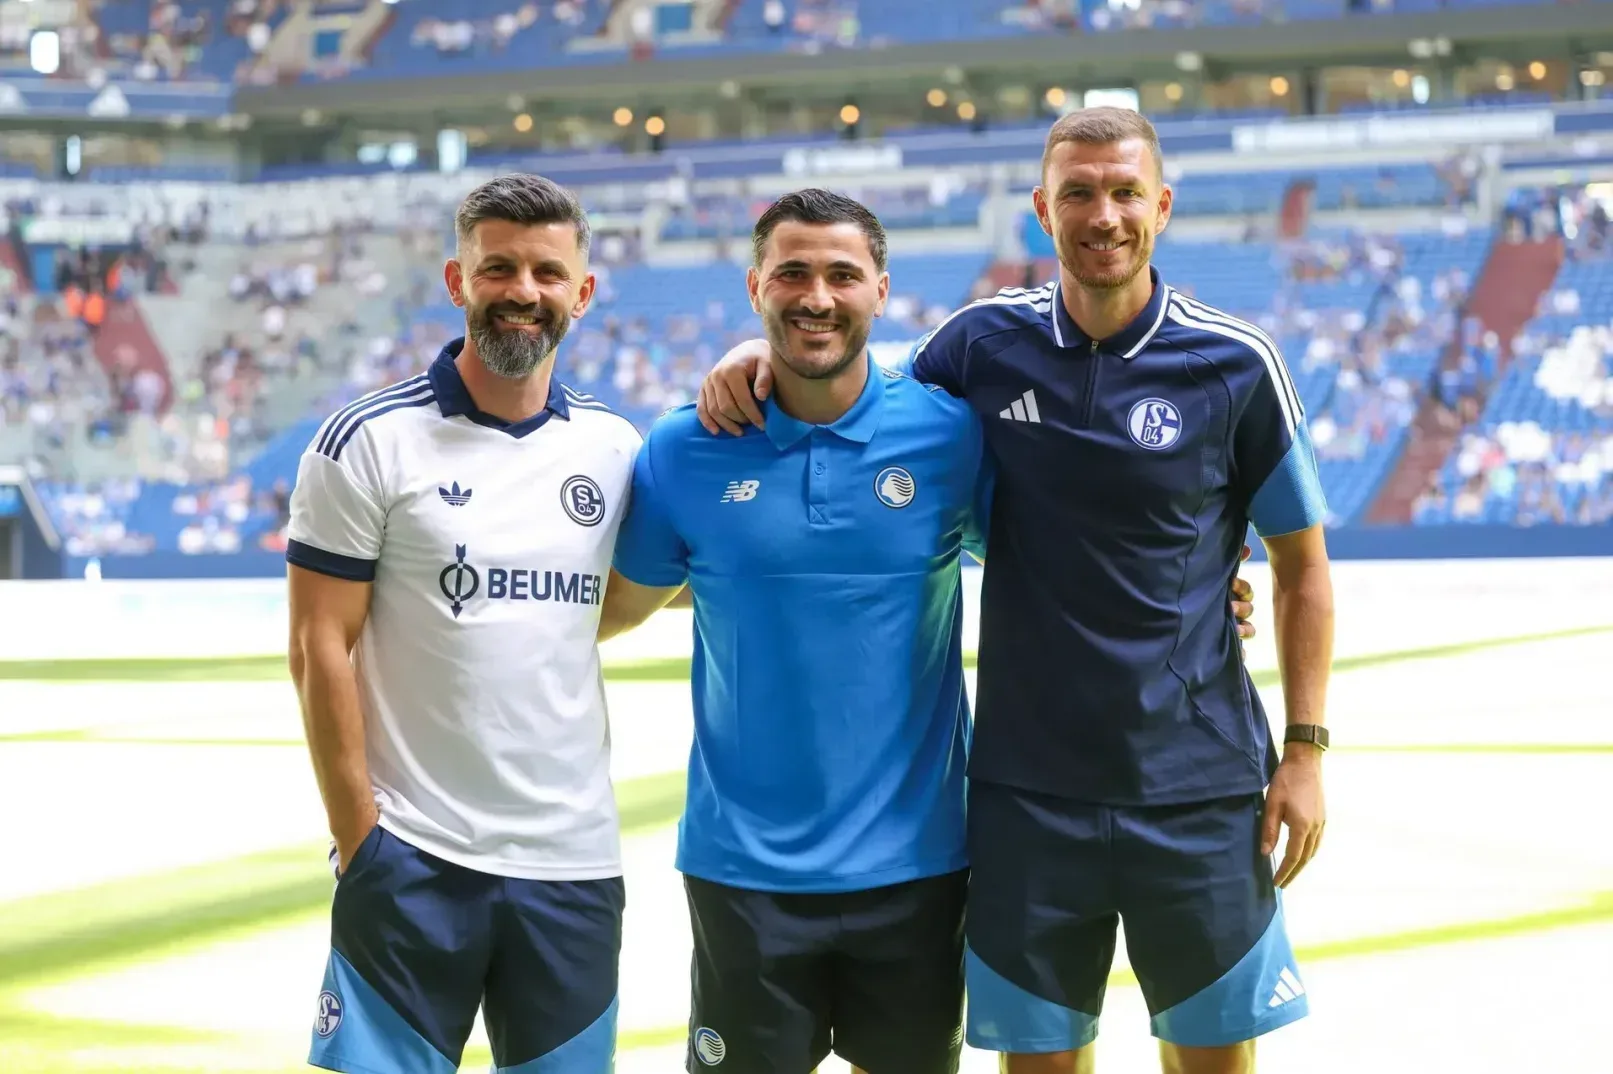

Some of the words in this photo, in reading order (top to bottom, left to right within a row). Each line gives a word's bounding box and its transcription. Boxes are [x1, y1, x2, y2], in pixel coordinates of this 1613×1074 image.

[1146, 403, 1165, 427] S
[1143, 427, 1159, 443] 04
[487, 568, 601, 605] BEUMER
